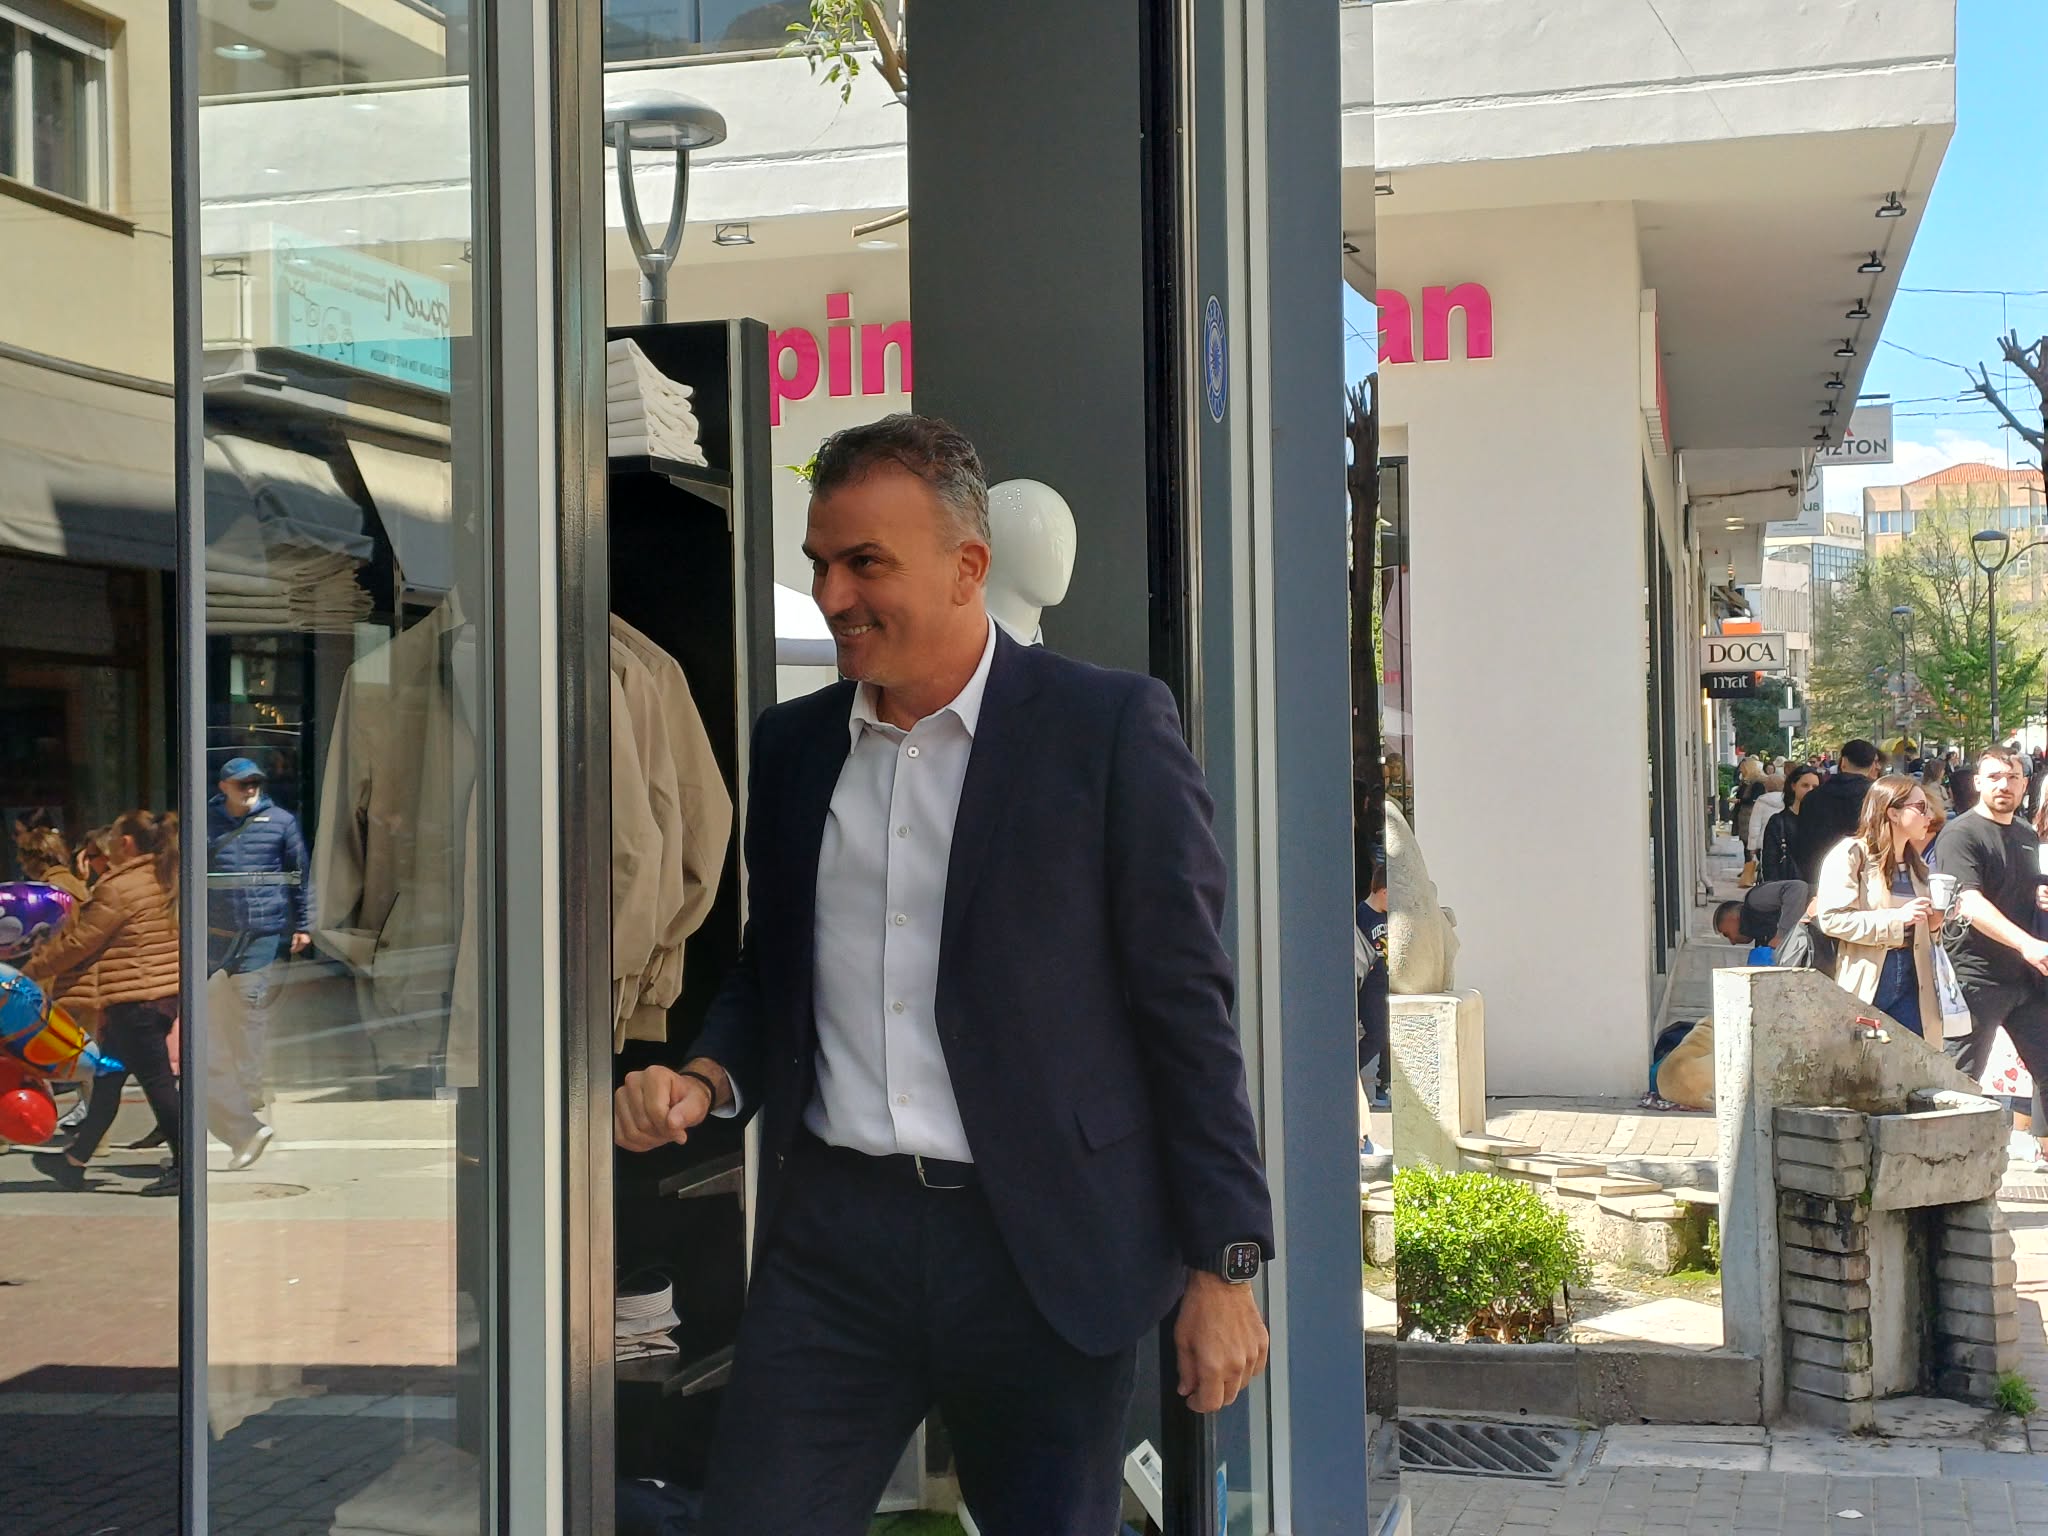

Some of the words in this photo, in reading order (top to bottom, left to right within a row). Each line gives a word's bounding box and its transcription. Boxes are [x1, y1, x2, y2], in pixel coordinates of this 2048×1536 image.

[768, 292, 912, 426] pin
[1376, 282, 1493, 364] an
[1708, 642, 1776, 663] DOCA
